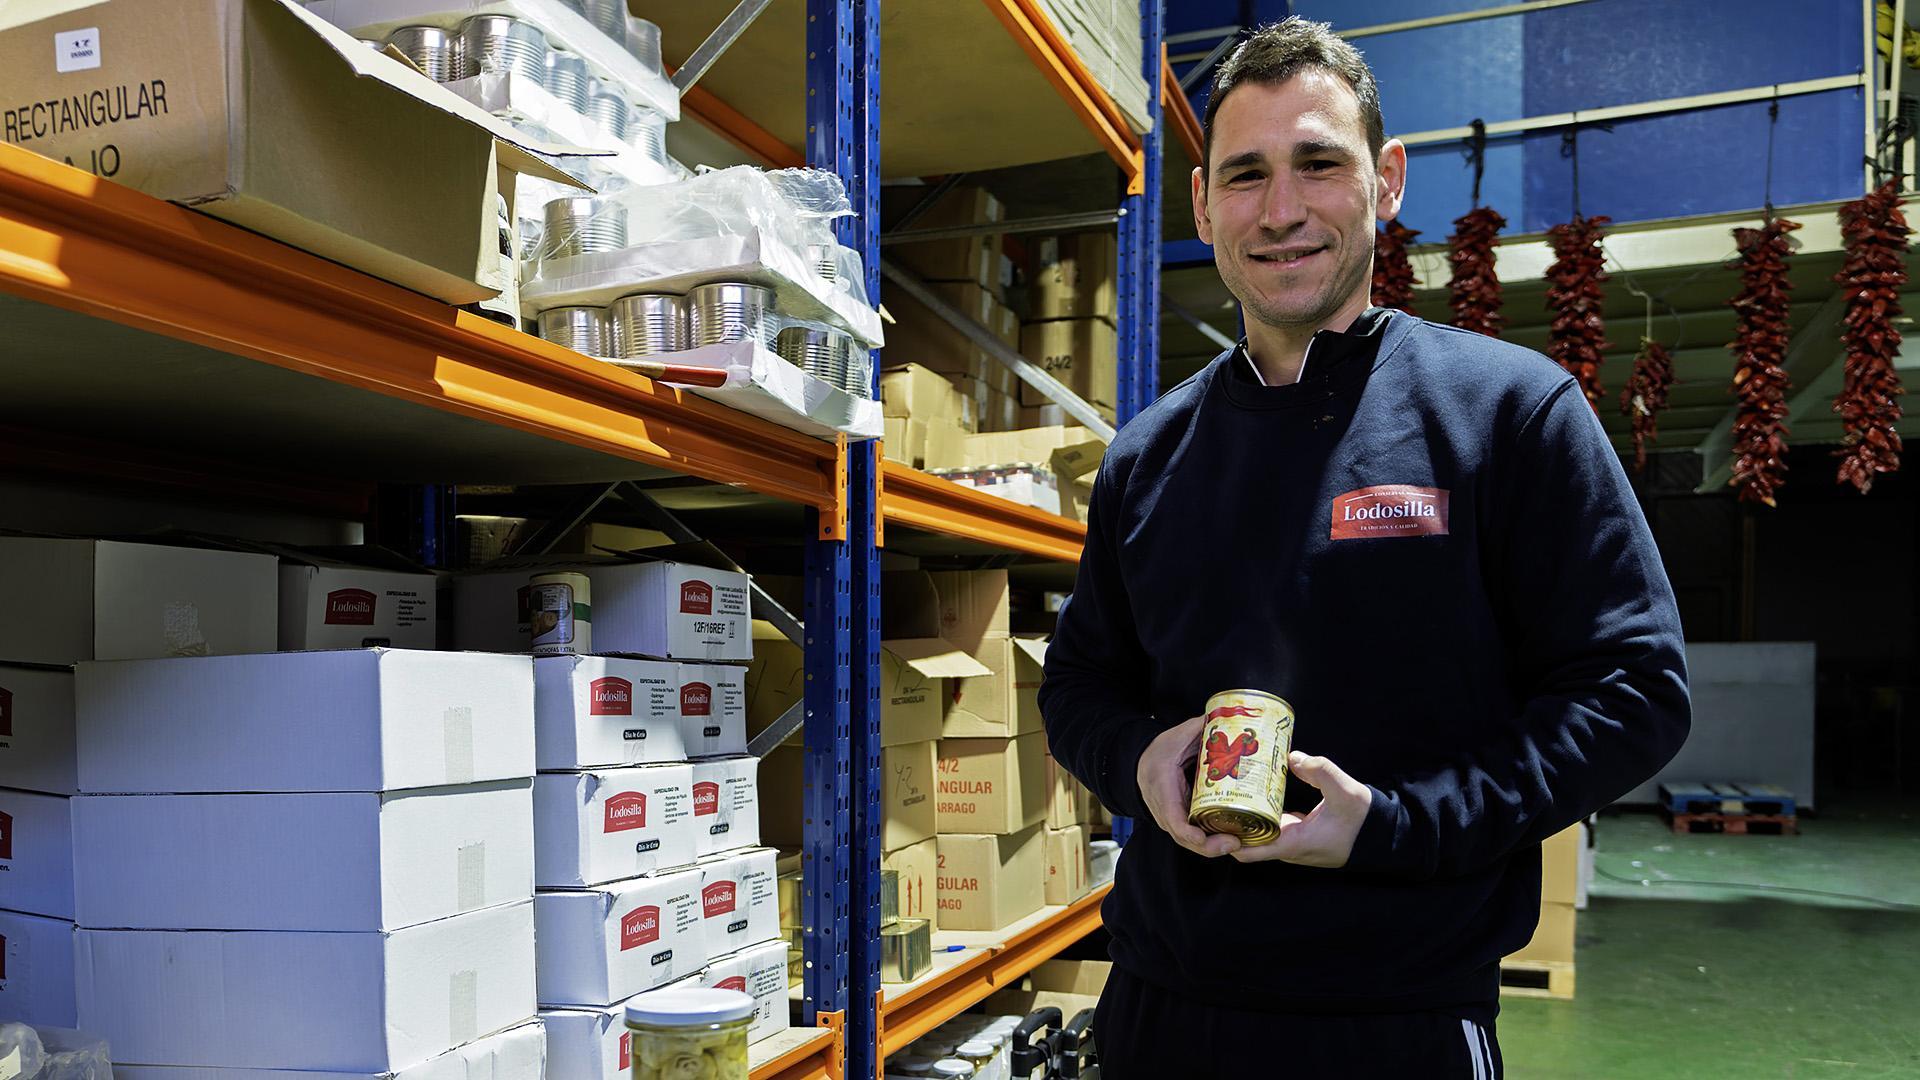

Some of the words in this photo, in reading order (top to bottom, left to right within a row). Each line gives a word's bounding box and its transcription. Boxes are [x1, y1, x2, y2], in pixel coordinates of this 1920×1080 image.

[5, 79, 169, 142] RECTANGULAR
[1343, 500, 1436, 521] Lodosilla
[684, 591, 709, 603] Lodosilla
[332, 600, 370, 613] Lodosilla
[693, 621, 726, 634] 12F/16REF
[595, 689, 628, 702] Lodosilla
[684, 693, 709, 704] Lodosilla
[937, 758, 959, 774] 4/2
[937, 780, 993, 794] NGULAR
[610, 803, 642, 819] Lodosilla
[937, 854, 946, 869] 2
[937, 876, 978, 892] GULAR
[704, 890, 732, 907] Lodosilla
[626, 917, 656, 936] Lodosilla
